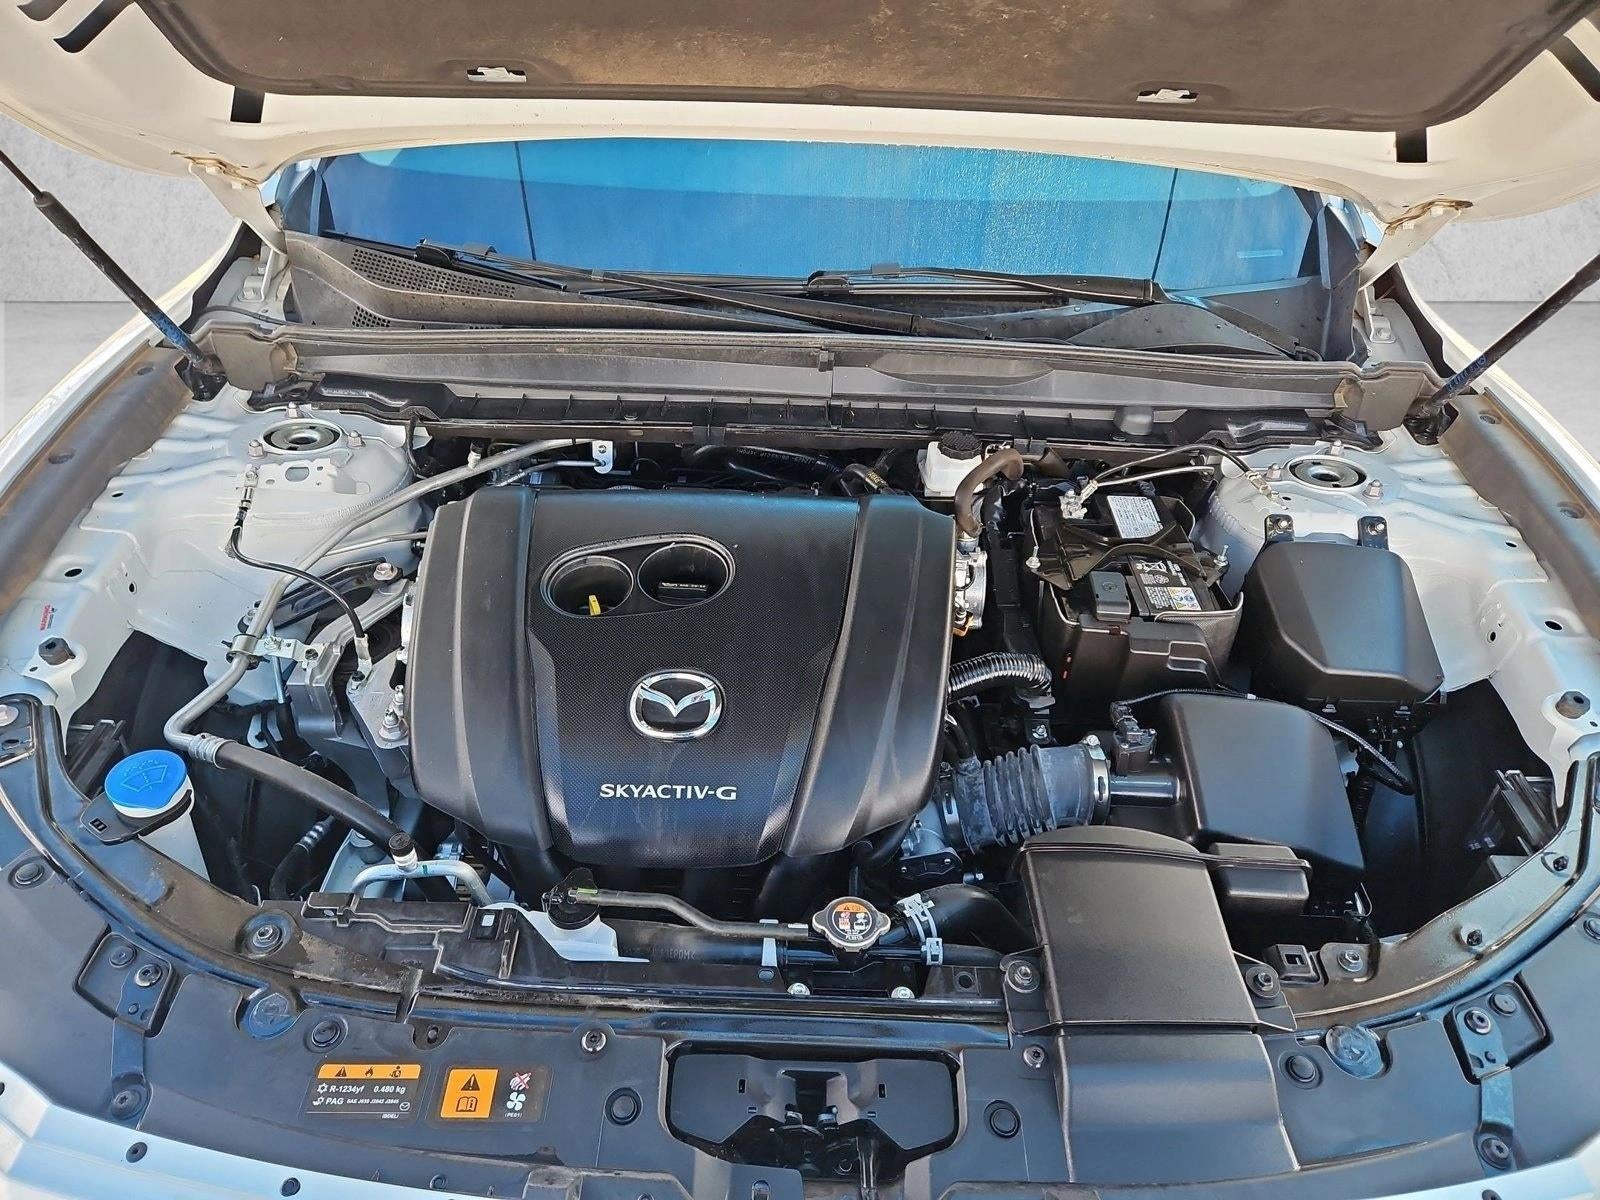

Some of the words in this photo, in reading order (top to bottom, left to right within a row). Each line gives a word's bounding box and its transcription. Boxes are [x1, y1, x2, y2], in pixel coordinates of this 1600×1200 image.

[600, 783, 737, 800] SKYACTIV-G
[329, 1085, 365, 1094] R-1234yf
[373, 1085, 395, 1093] 0.480
[395, 1085, 406, 1095] kg
[325, 1097, 344, 1105] PAG
